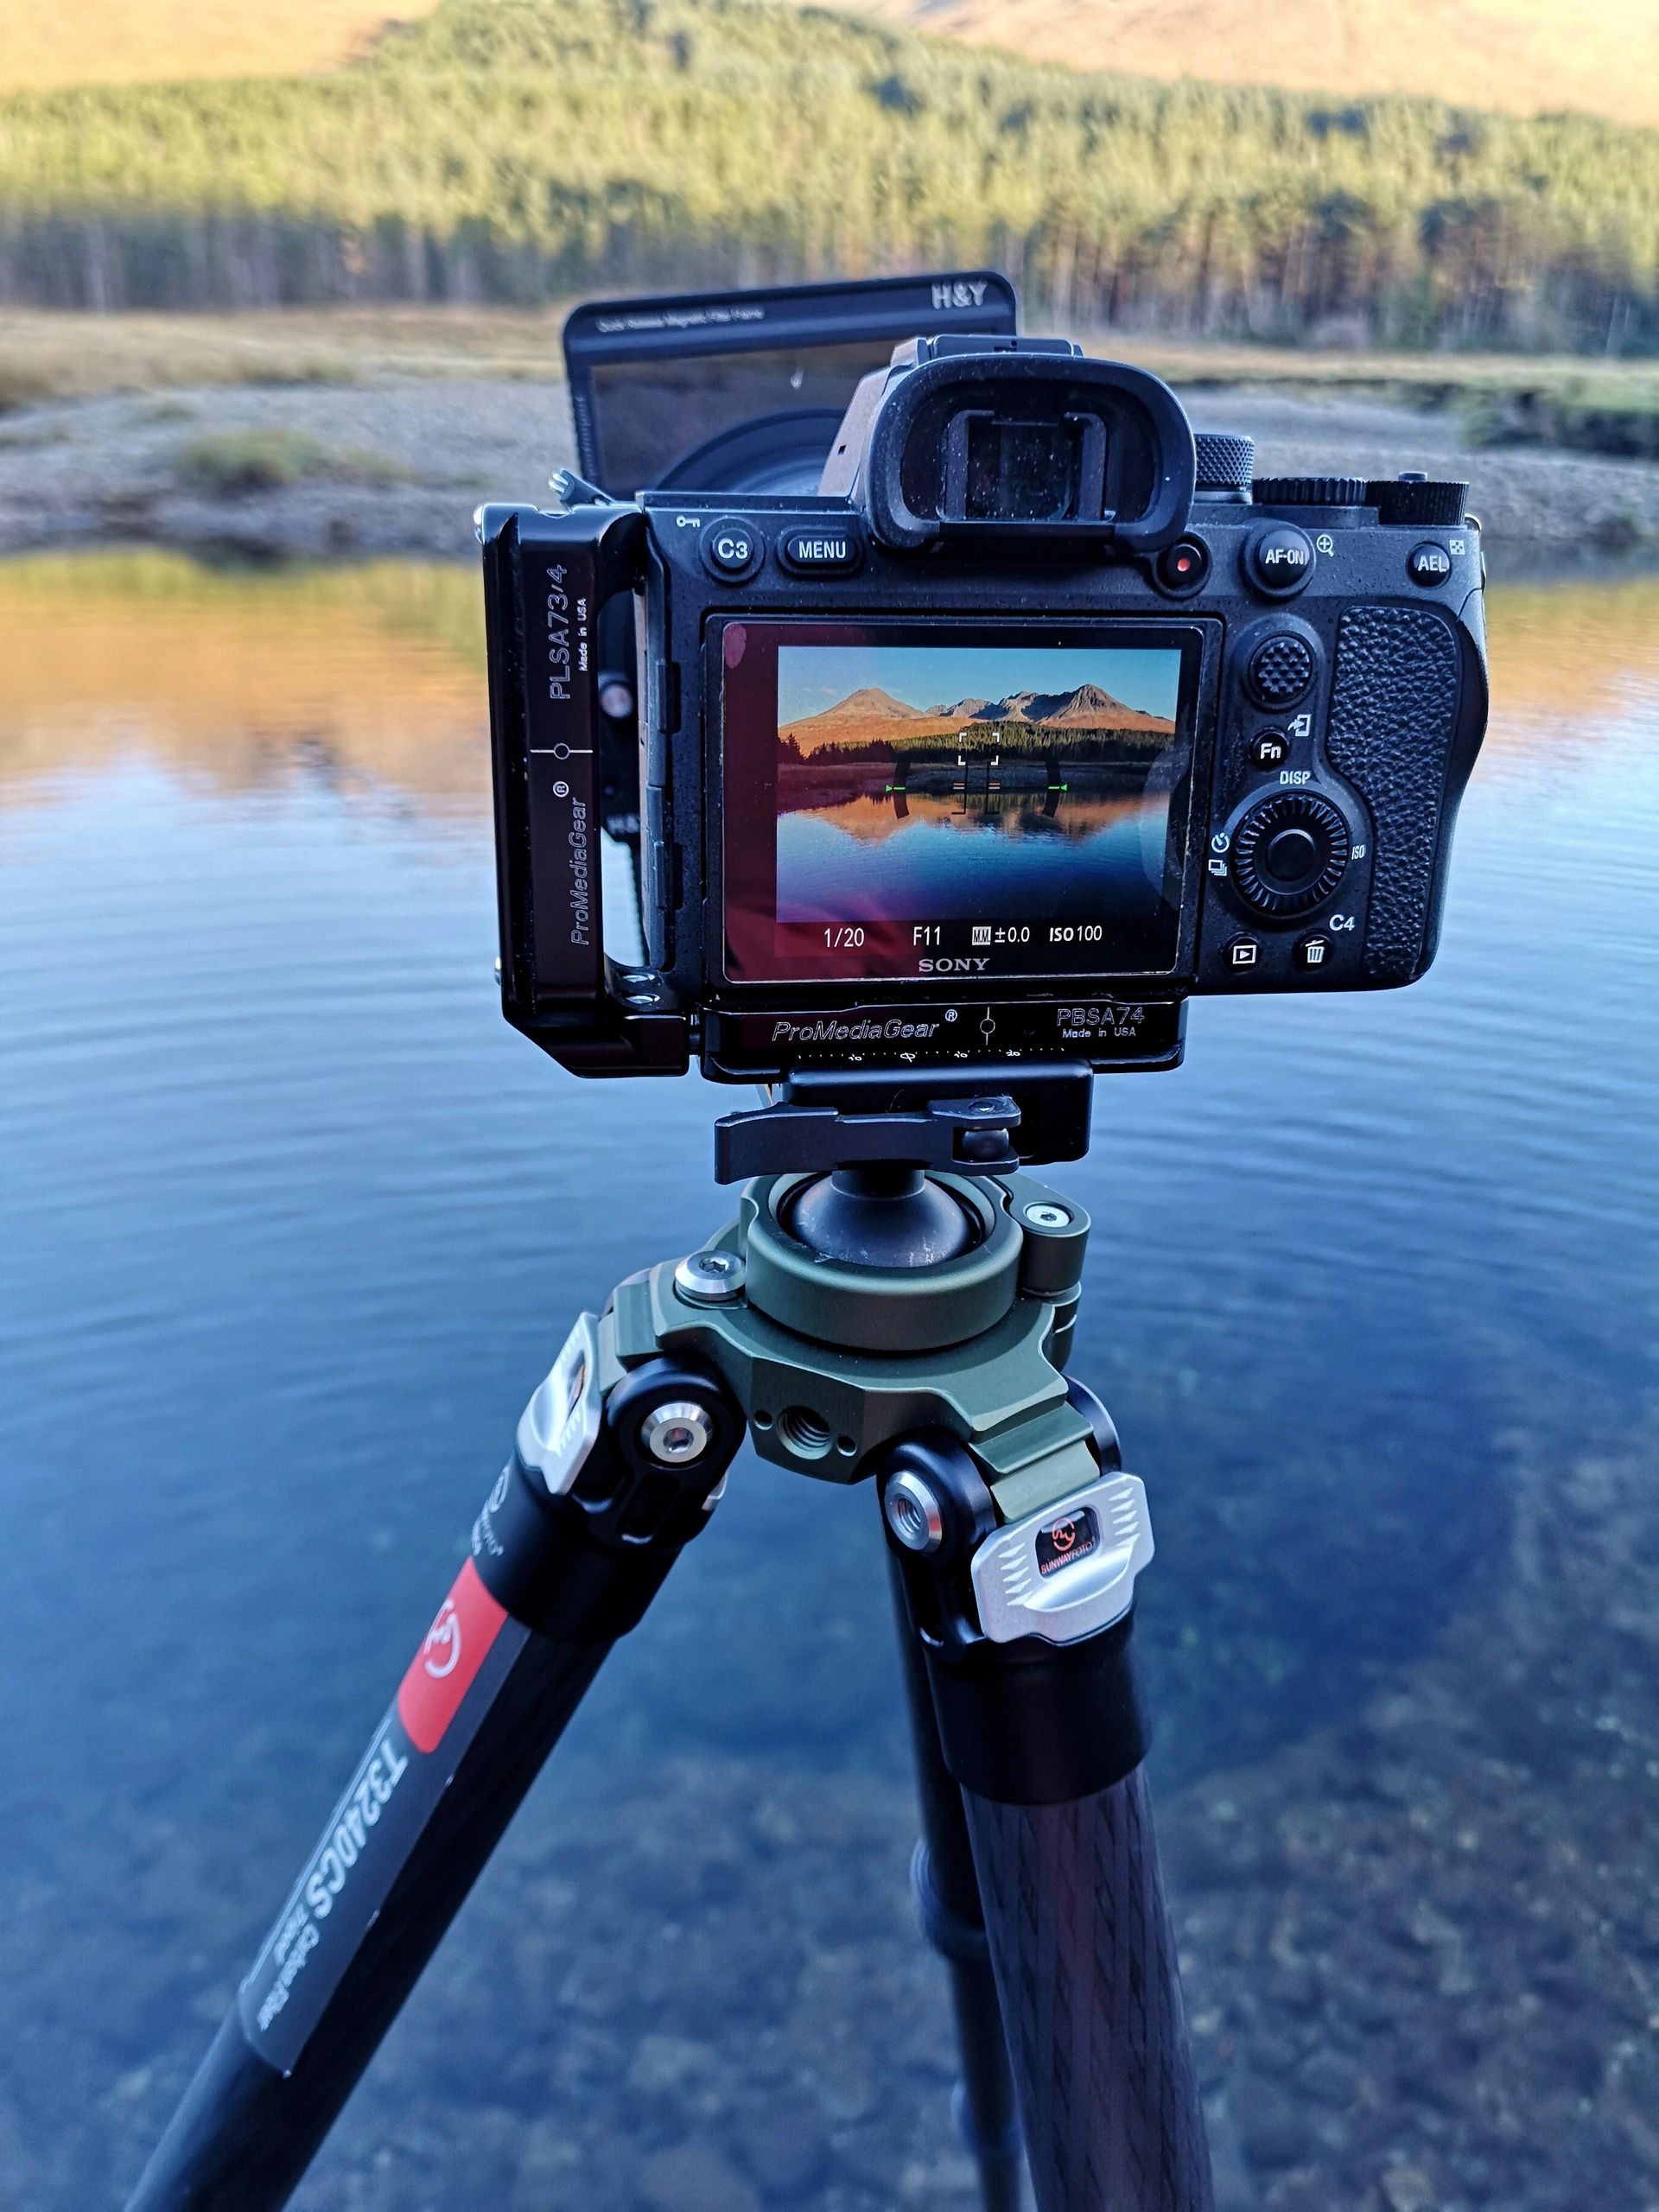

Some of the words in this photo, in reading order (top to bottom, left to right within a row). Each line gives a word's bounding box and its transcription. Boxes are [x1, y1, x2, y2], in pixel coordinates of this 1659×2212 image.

[931, 281, 988, 309] H&Y
[717, 537, 748, 559] C3
[798, 540, 846, 558] MENU
[1265, 548, 1306, 565] AF-ON
[1417, 555, 1449, 573] AEL
[576, 597, 588, 621] USA
[546, 564, 571, 700] PLSA73/4
[577, 626, 588, 637] in
[578, 642, 588, 671] Made
[1260, 743, 1281, 760] Fn
[1280, 771, 1311, 785] DISP
[1351, 844, 1366, 860] ISO
[568, 797, 589, 945] ProMediaGear
[1329, 914, 1355, 931] C4
[824, 927, 865, 948] 1/20
[912, 925, 941, 946] F11
[918, 957, 990, 973] SONY
[1057, 1007, 1145, 1026] PBSA74
[772, 1019, 940, 1041] ProMediaGear
[1062, 1028, 1091, 1039] Made
[1098, 1027, 1107, 1037] in
[1114, 1027, 1136, 1037] USA
[1040, 1541, 1093, 1574] SUNWAYFOTO
[305, 1738, 409, 1920] T3240CS
